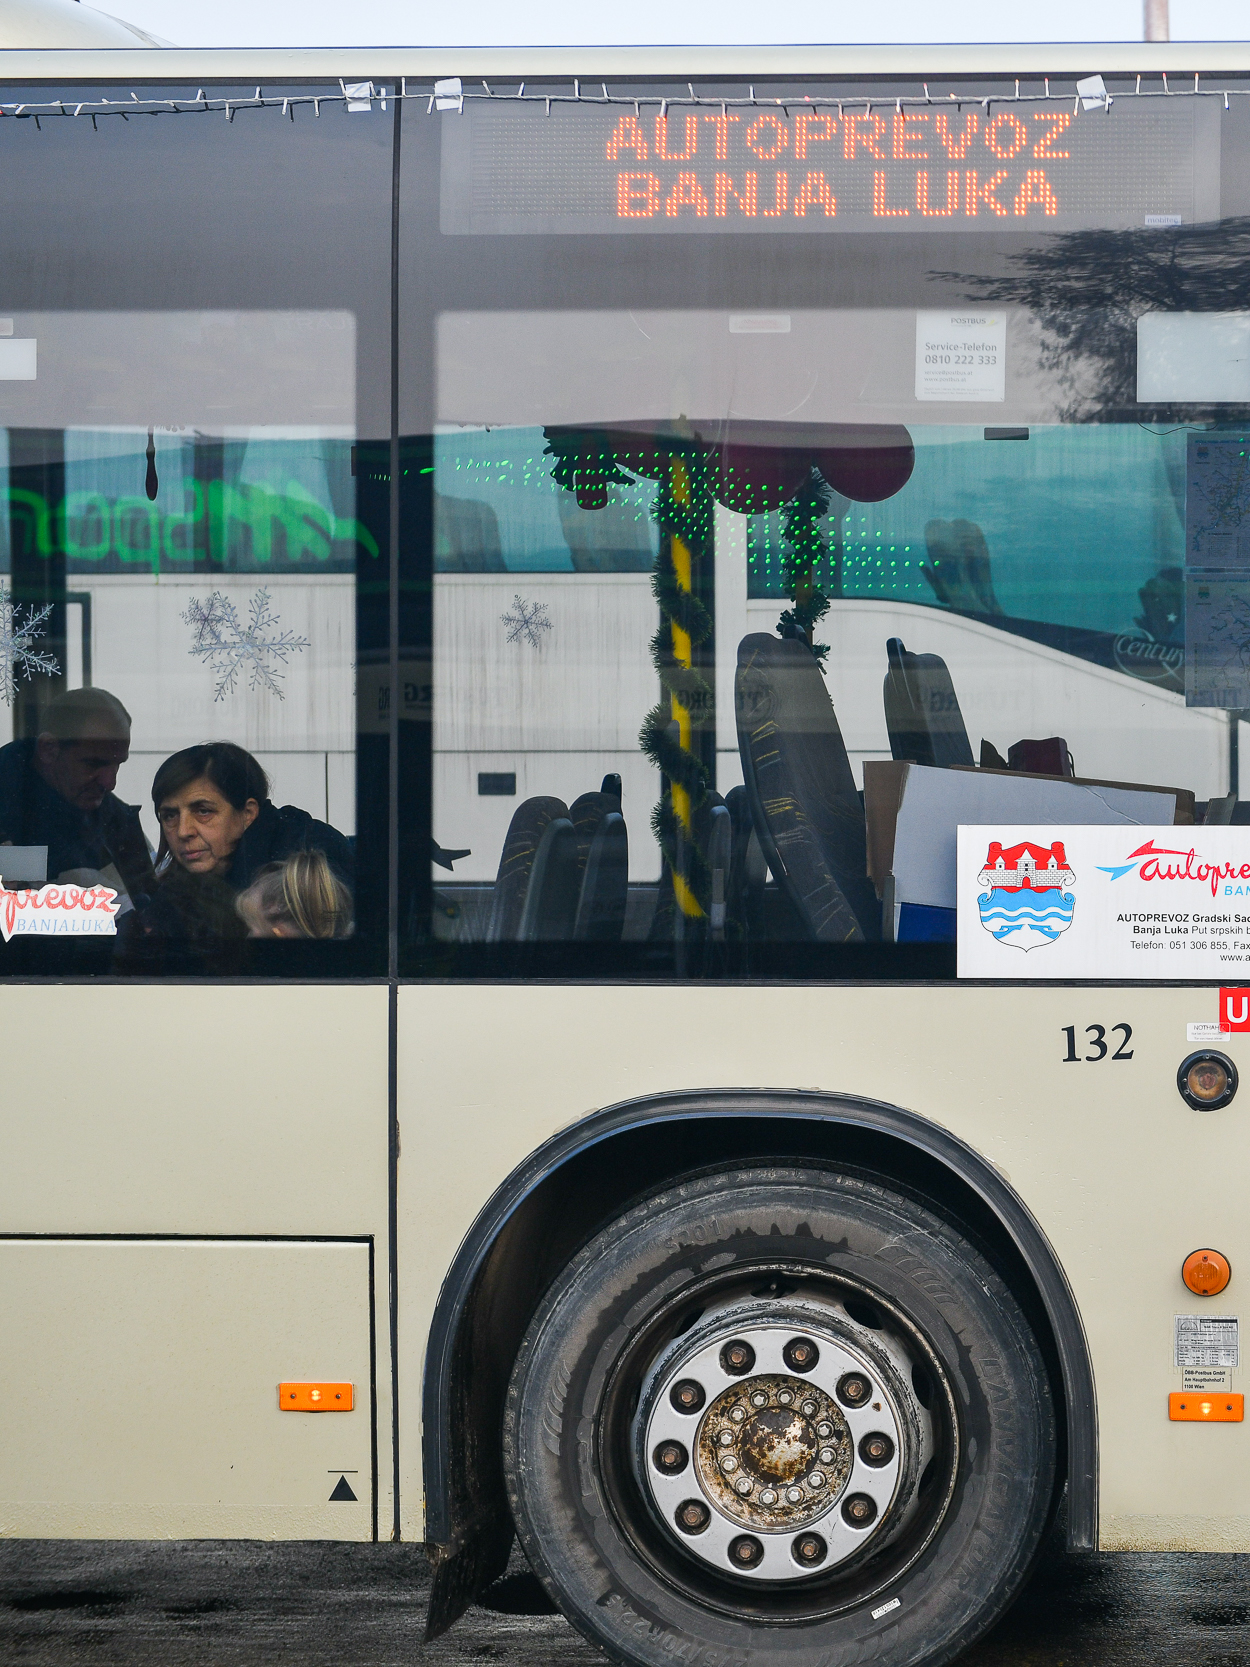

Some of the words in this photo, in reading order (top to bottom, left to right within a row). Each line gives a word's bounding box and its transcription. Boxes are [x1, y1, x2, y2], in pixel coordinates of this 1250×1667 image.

[606, 114, 1071, 160] AUTOPREVOZ
[617, 170, 837, 217] BANJA
[873, 170, 1058, 217] LUKA
[950, 317, 987, 325] POSTBUS
[925, 342, 997, 352] Service-Telefon
[924, 354, 951, 364] 0810
[954, 354, 974, 365] 222
[977, 355, 997, 365] 333
[1116, 636, 1185, 662] Centur
[0, 888, 116, 934] prevoz
[1116, 913, 1190, 923] AUTOPREVOZ
[1192, 913, 1231, 923] Gradski
[17, 918, 115, 934] BANJALUKA
[1133, 925, 1161, 936] Banja
[1164, 925, 1189, 934] Luka
[1191, 926, 1208, 935] Put
[1210, 925, 1243, 936] srpskih
[1130, 940, 1167, 950] Telefon:
[1169, 941, 1187, 950] 051
[1190, 941, 1208, 950] 306
[1061, 1022, 1135, 1062] 132
